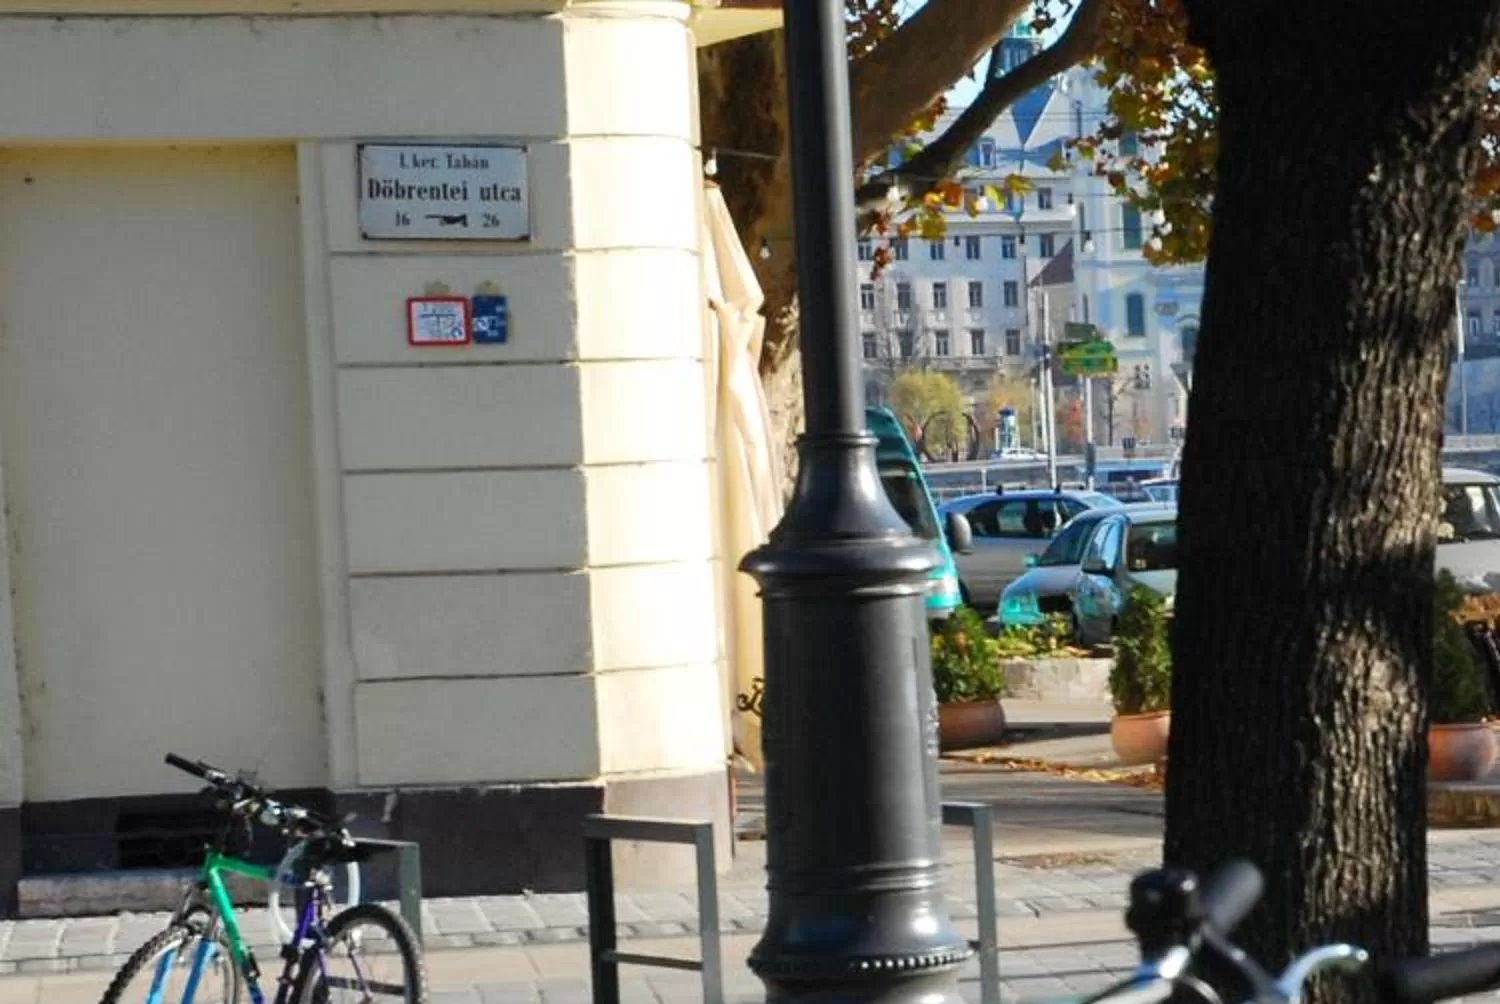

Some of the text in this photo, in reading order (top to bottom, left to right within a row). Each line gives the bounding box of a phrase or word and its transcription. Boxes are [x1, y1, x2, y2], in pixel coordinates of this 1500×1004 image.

[367, 177, 522, 201] Döbrentei utca
[395, 210, 501, 228] 16 26
